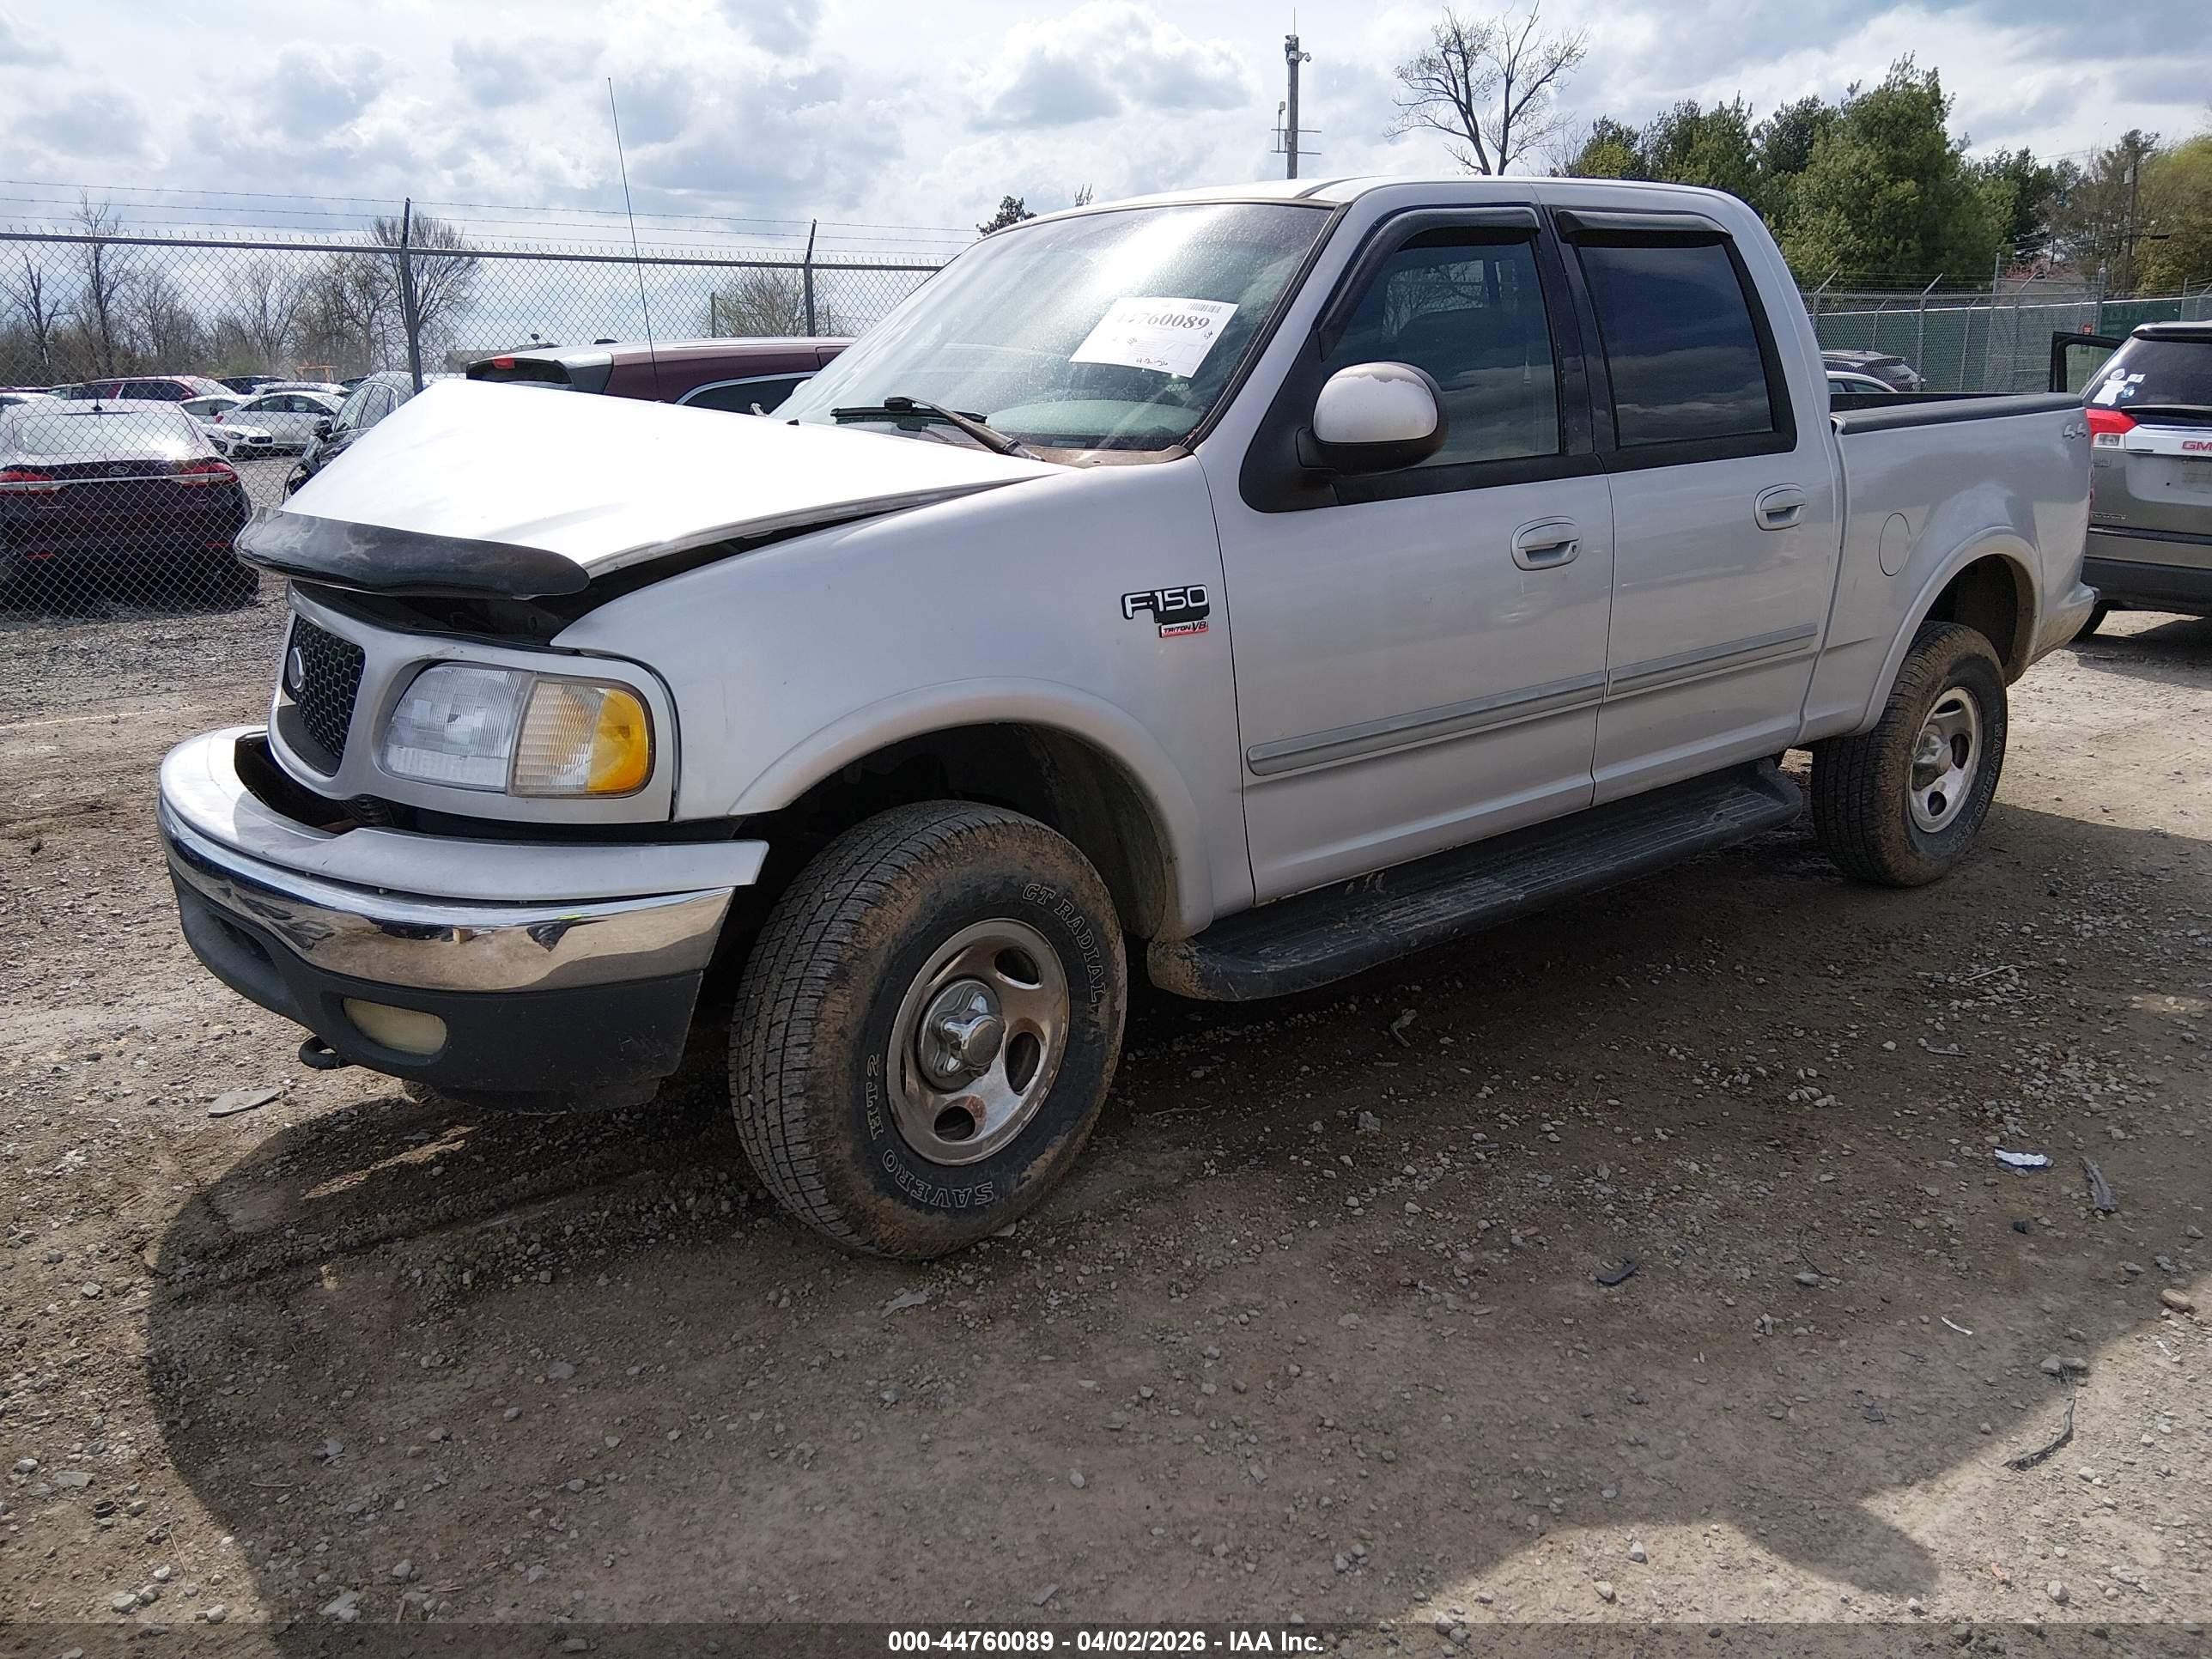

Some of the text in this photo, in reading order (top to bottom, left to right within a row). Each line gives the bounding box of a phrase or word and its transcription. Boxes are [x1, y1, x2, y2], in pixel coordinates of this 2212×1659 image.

[1163, 621, 1206, 634] TRITON V8
[1021, 883, 1108, 1004] GT RADIAL
[865, 1054, 995, 1209] SAVERO HT2
